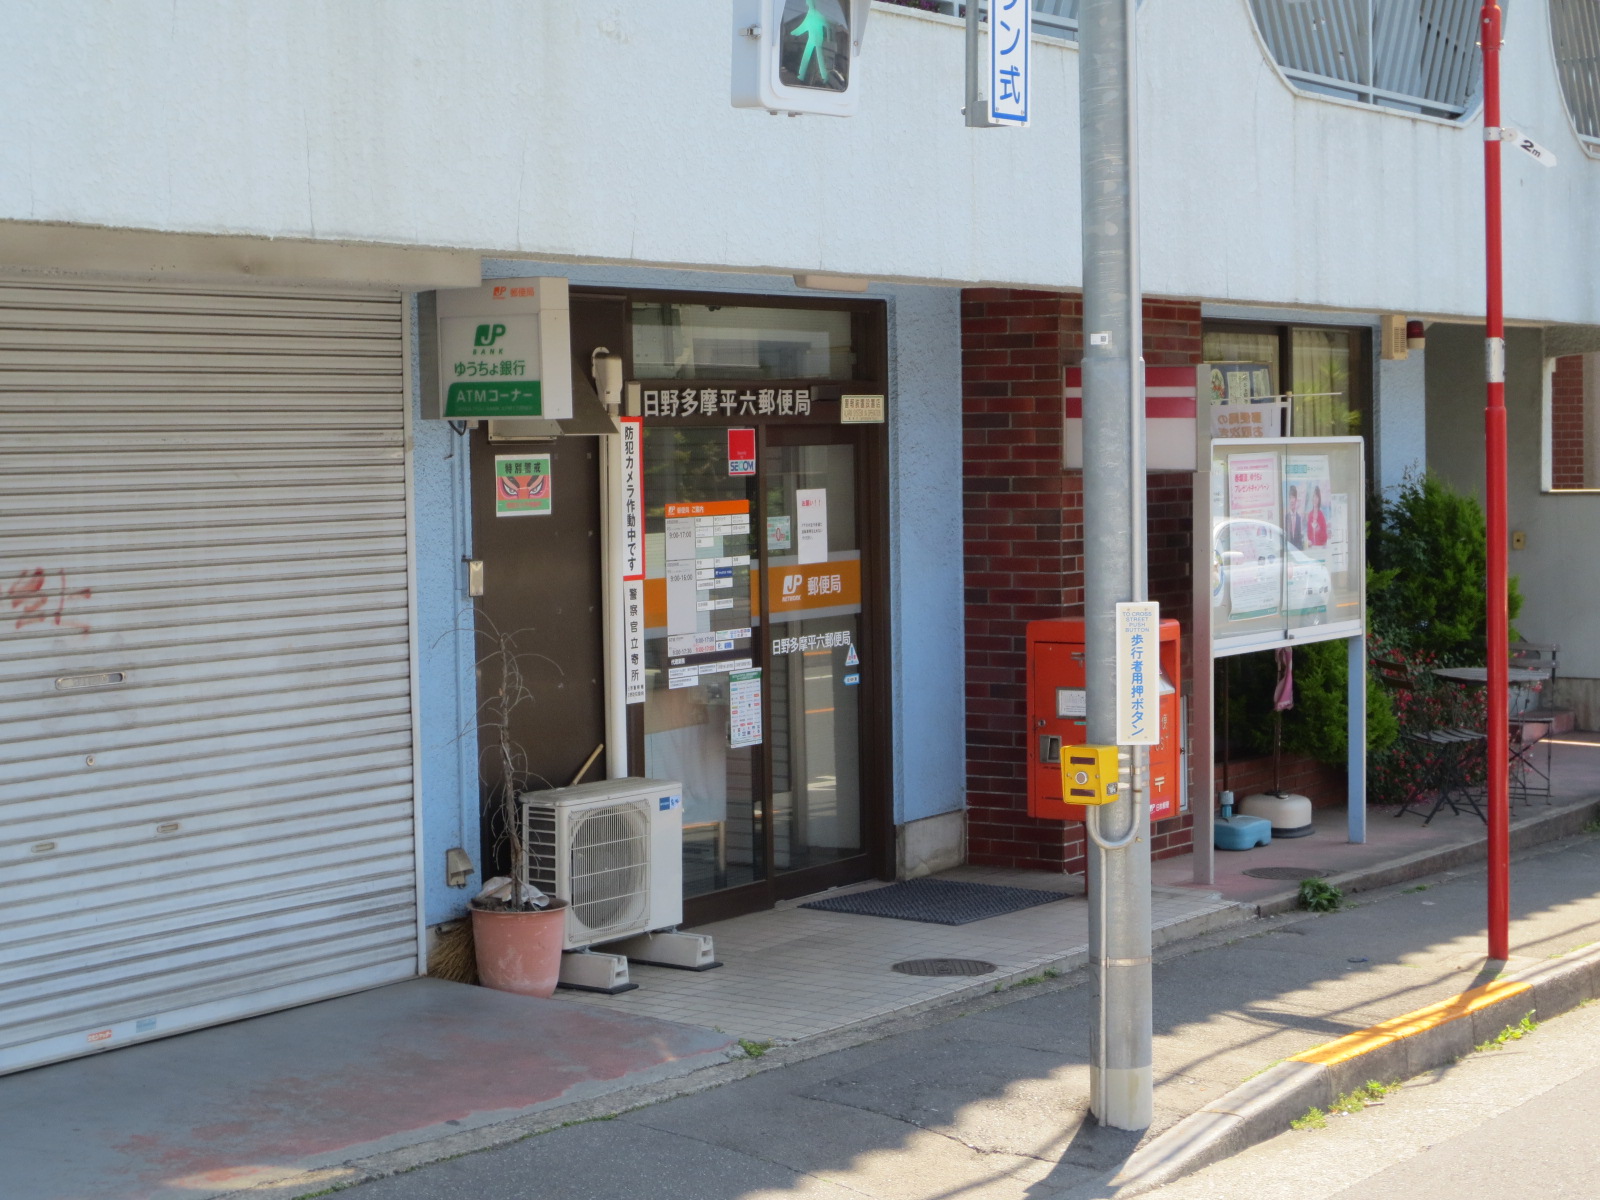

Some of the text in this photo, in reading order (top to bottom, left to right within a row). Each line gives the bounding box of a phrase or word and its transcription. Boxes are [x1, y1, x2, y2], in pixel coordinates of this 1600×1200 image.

[1520, 139, 1541, 158] 2m
[454, 359, 526, 377] ゆうちょ銀行
[456, 388, 533, 403] ATMコーナー
[643, 388, 812, 417] 日野多摩平六郵便局
[504, 462, 541, 474] 特別警戒
[730, 461, 754, 472] SECOM
[624, 425, 637, 573] 防犯カメラ作動中です
[807, 574, 842, 596] 郵便局
[628, 588, 640, 682] 警察官立寄所
[772, 630, 851, 656] 日野多摩平六郵便局
[1130, 634, 1145, 736] 歩行者用押ボタン
